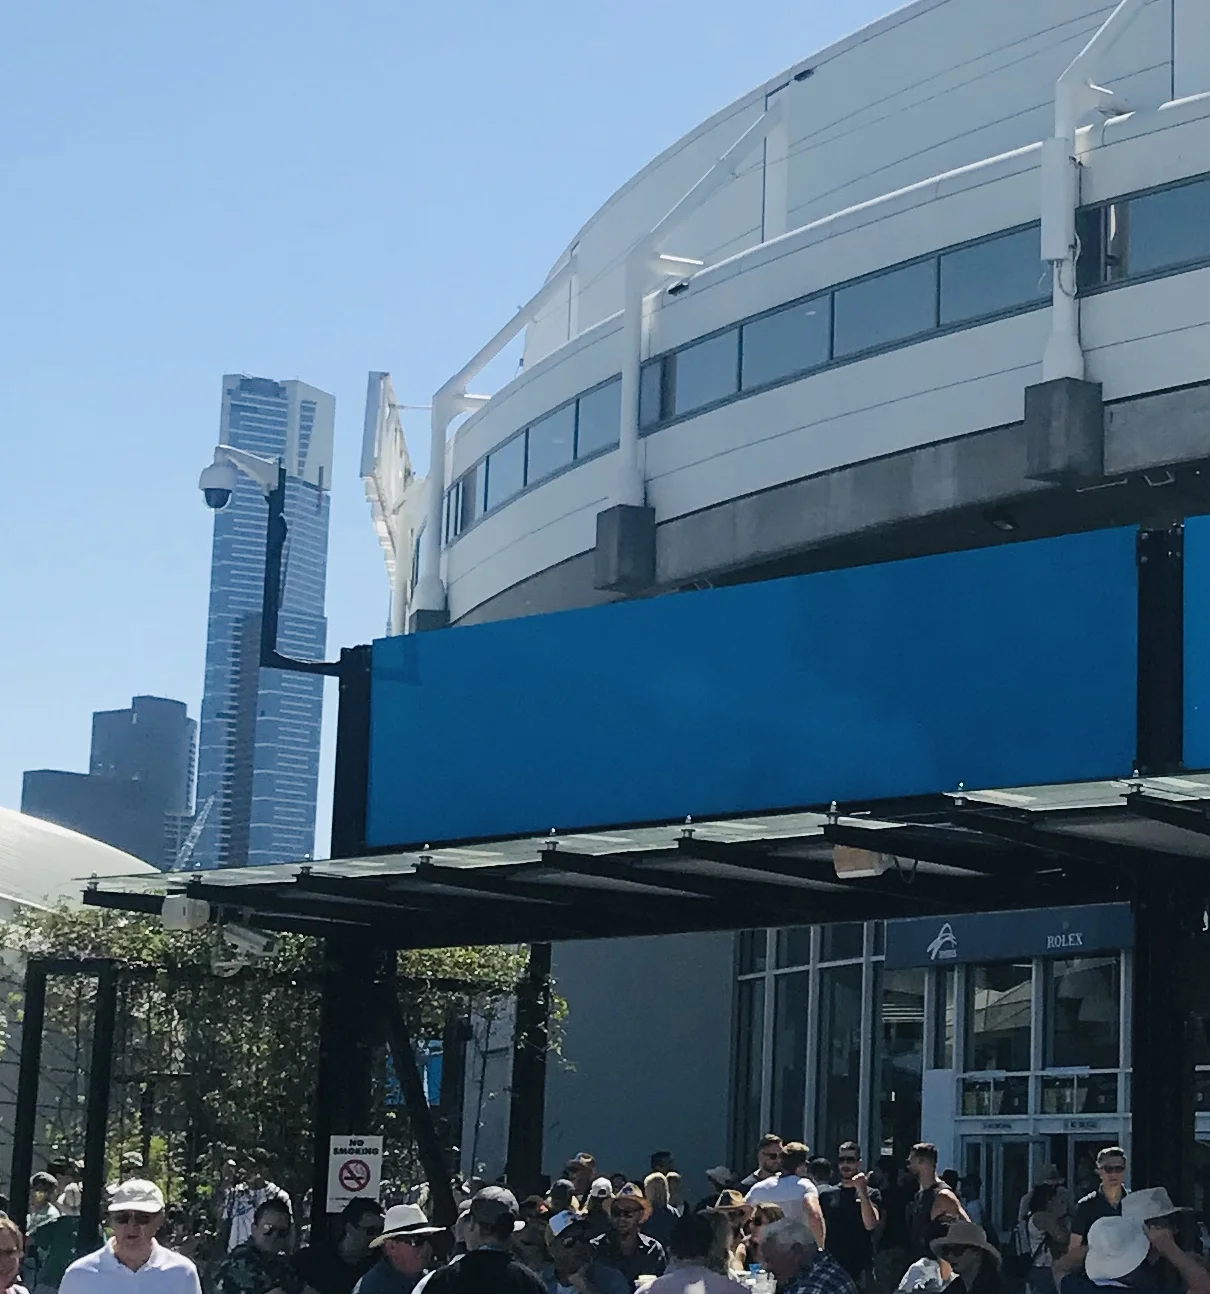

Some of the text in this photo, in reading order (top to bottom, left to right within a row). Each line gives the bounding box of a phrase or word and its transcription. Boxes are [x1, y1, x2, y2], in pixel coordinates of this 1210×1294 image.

[1046, 932, 1083, 949] ROLEX
[348, 1139, 364, 1147] NO
[333, 1147, 380, 1155] SMOKING
